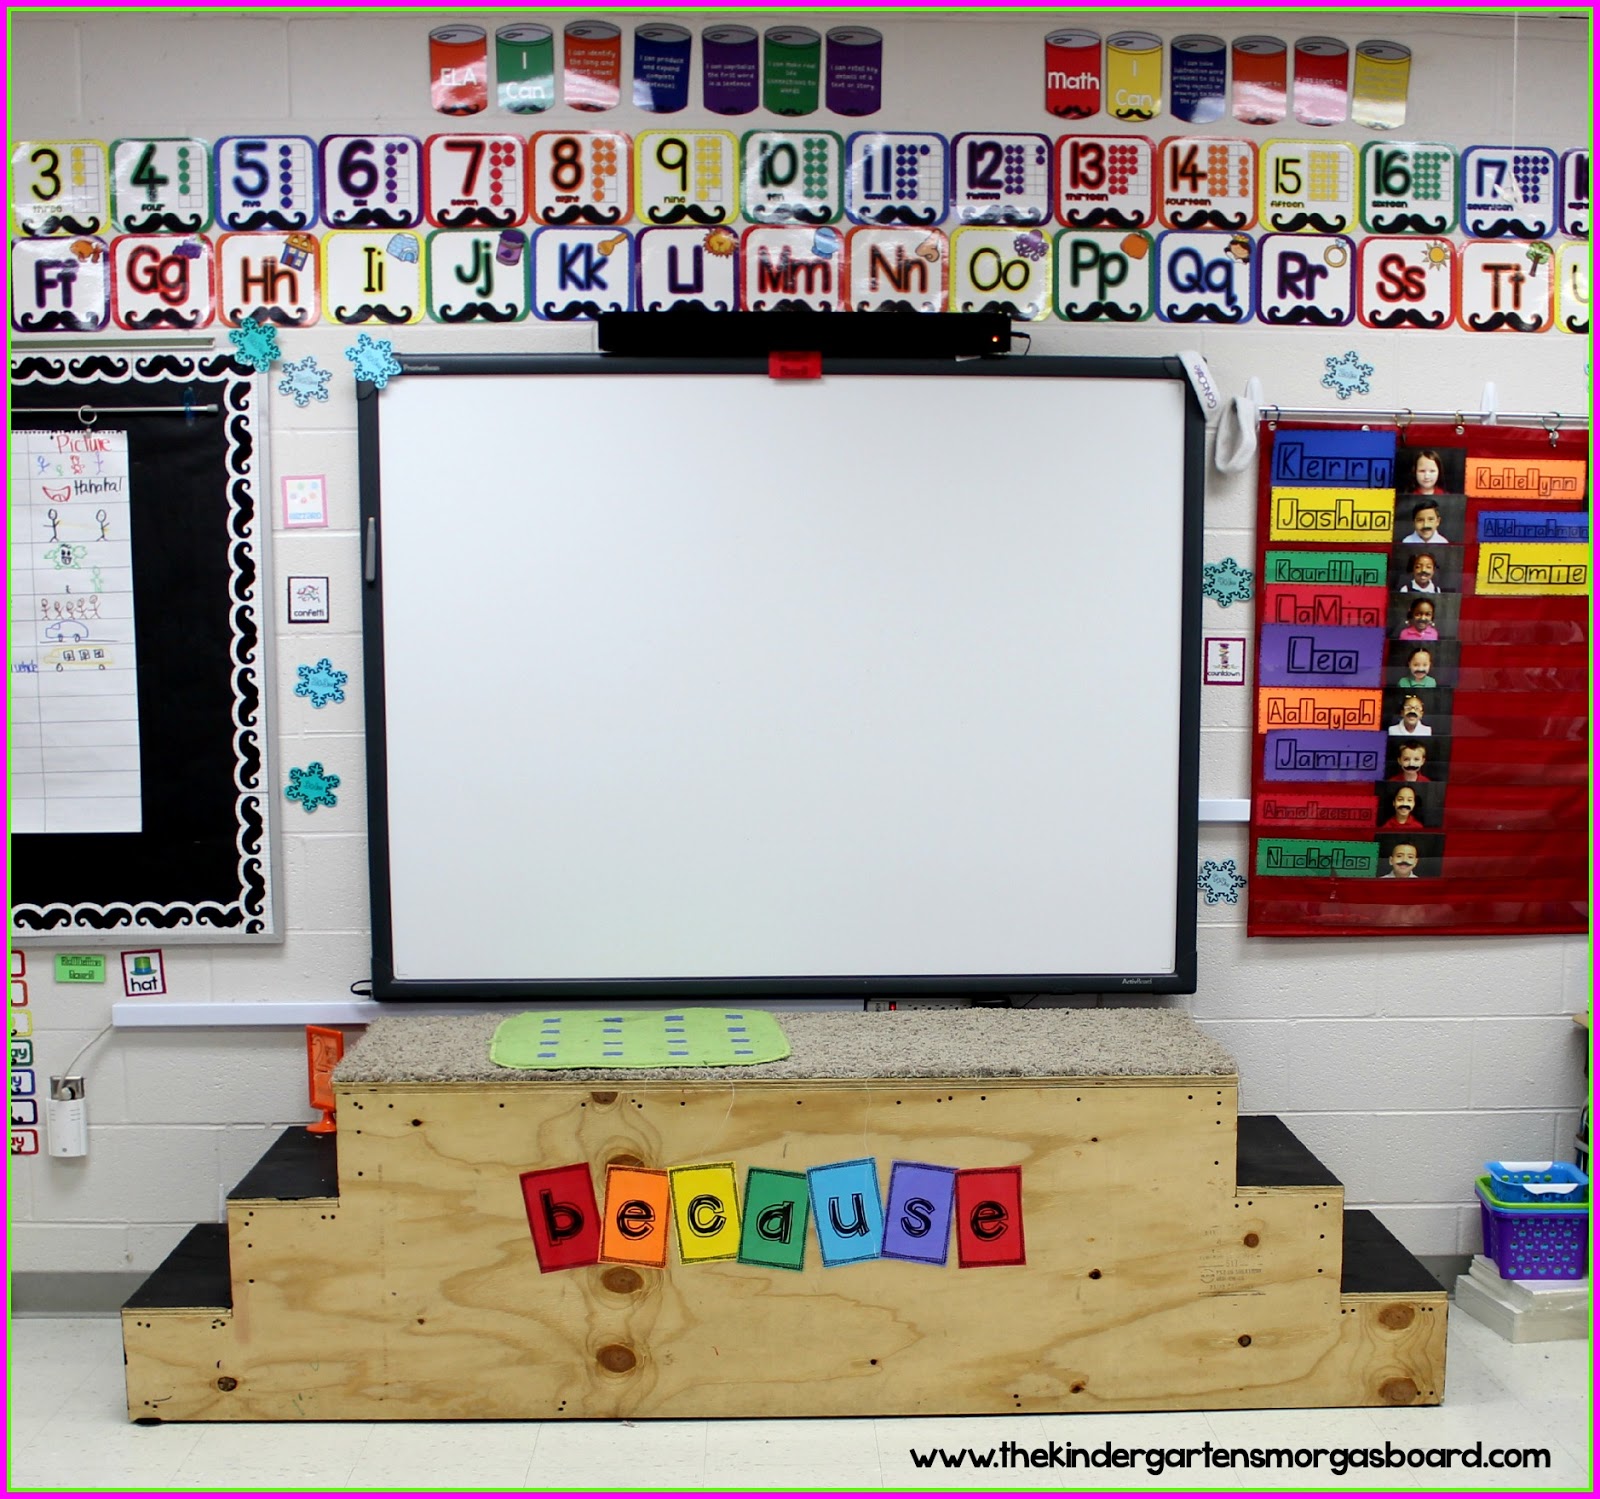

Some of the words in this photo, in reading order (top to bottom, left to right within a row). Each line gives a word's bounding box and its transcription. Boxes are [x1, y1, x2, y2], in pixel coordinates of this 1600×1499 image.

[440, 67, 477, 86] ELA
[522, 51, 527, 70] I
[1047, 71, 1100, 90] Math
[1132, 59, 1138, 78] I
[506, 81, 546, 99] Can
[1115, 88, 1153, 107] Can
[29, 147, 62, 202] 3
[131, 142, 170, 201] 4
[233, 140, 270, 199] 5
[338, 139, 380, 199] 6
[443, 139, 486, 197] 7
[550, 137, 584, 192] 8
[655, 137, 689, 193] 9
[760, 140, 798, 190] 10
[863, 143, 892, 193] 11
[967, 140, 1004, 190] 12
[1069, 140, 1106, 190] 13
[1170, 143, 1207, 193] 14
[1274, 157, 1302, 195] 15
[1374, 149, 1412, 198] 16
[1477, 157, 1509, 198] 17
[141, 203, 167, 213] four
[664, 195, 686, 204] nine
[965, 192, 1001, 201] twelve
[1065, 192, 1109, 202] thirteen
[1165, 197, 1211, 206] fourteen
[1270, 200, 1305, 209] fifteen
[1371, 200, 1409, 209] sixteen
[1466, 202, 1515, 212] seventeen
[34, 259, 79, 309] Ff
[126, 244, 191, 306] Gg
[240, 256, 300, 305] Hh
[363, 246, 386, 293] Ii
[454, 238, 494, 299] Jj
[558, 242, 609, 291] Kk
[758, 244, 832, 295] Mm
[868, 243, 929, 293] Nn
[968, 245, 1031, 292] Oo
[1070, 238, 1129, 301] Pp
[1167, 245, 1238, 308] Qq
[1277, 250, 1328, 301] Rr
[1375, 253, 1427, 302] Ss
[1481, 262, 1526, 311] Tt
[57, 434, 112, 454] Picture
[1280, 448, 1387, 489] Kerry
[1479, 468, 1575, 495] Katelynn
[1282, 501, 1388, 528] Joshua
[1277, 560, 1378, 586] Kourtlyn
[1490, 556, 1586, 582] Romie
[294, 609, 325, 617] confetti
[1278, 596, 1378, 625] LaMia
[1291, 639, 1355, 671] Lea
[1269, 700, 1373, 728] Aalayah
[1279, 741, 1376, 767] Jamie
[1268, 848, 1369, 867] Nicholas
[130, 976, 157, 992] hat
[540, 1188, 1010, 1247] because
